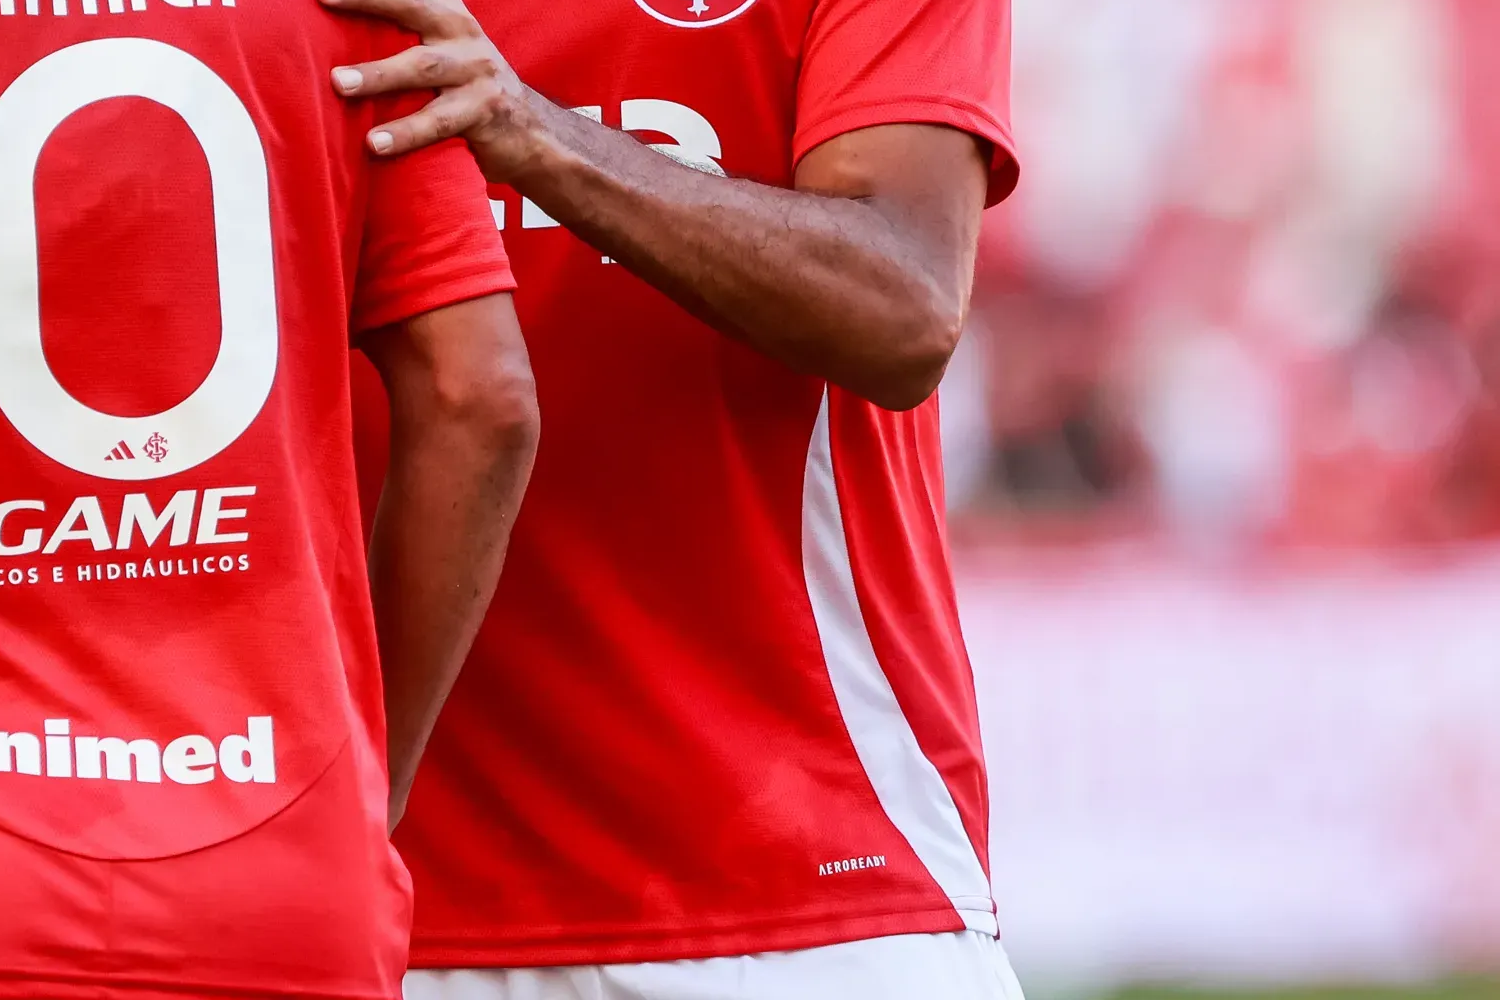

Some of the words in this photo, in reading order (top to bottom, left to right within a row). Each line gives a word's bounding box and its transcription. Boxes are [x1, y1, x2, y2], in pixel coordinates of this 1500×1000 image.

[52, 566, 65, 583] E
[77, 553, 251, 582] HIDRÁULICOS
[818, 855, 887, 877] AEROREADY
